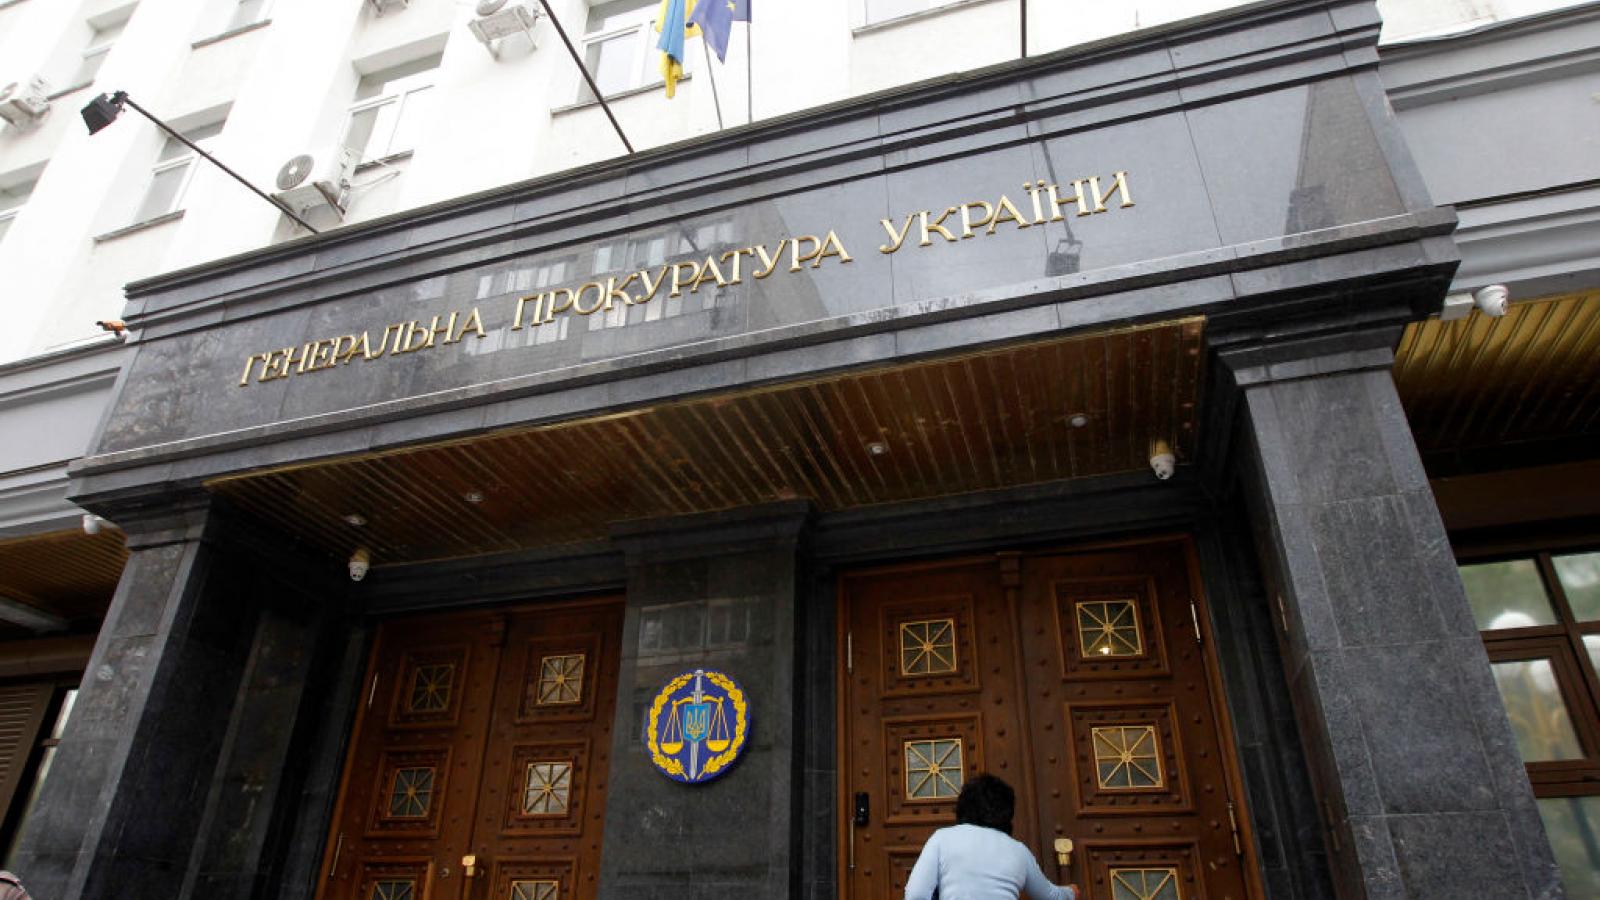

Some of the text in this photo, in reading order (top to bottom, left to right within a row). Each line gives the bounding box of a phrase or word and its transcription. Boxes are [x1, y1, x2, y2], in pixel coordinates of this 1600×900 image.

[240, 171, 1135, 386] ГЕНЕРАЛЬНА ПРОКУРАТУРА УКРАЇНИ
